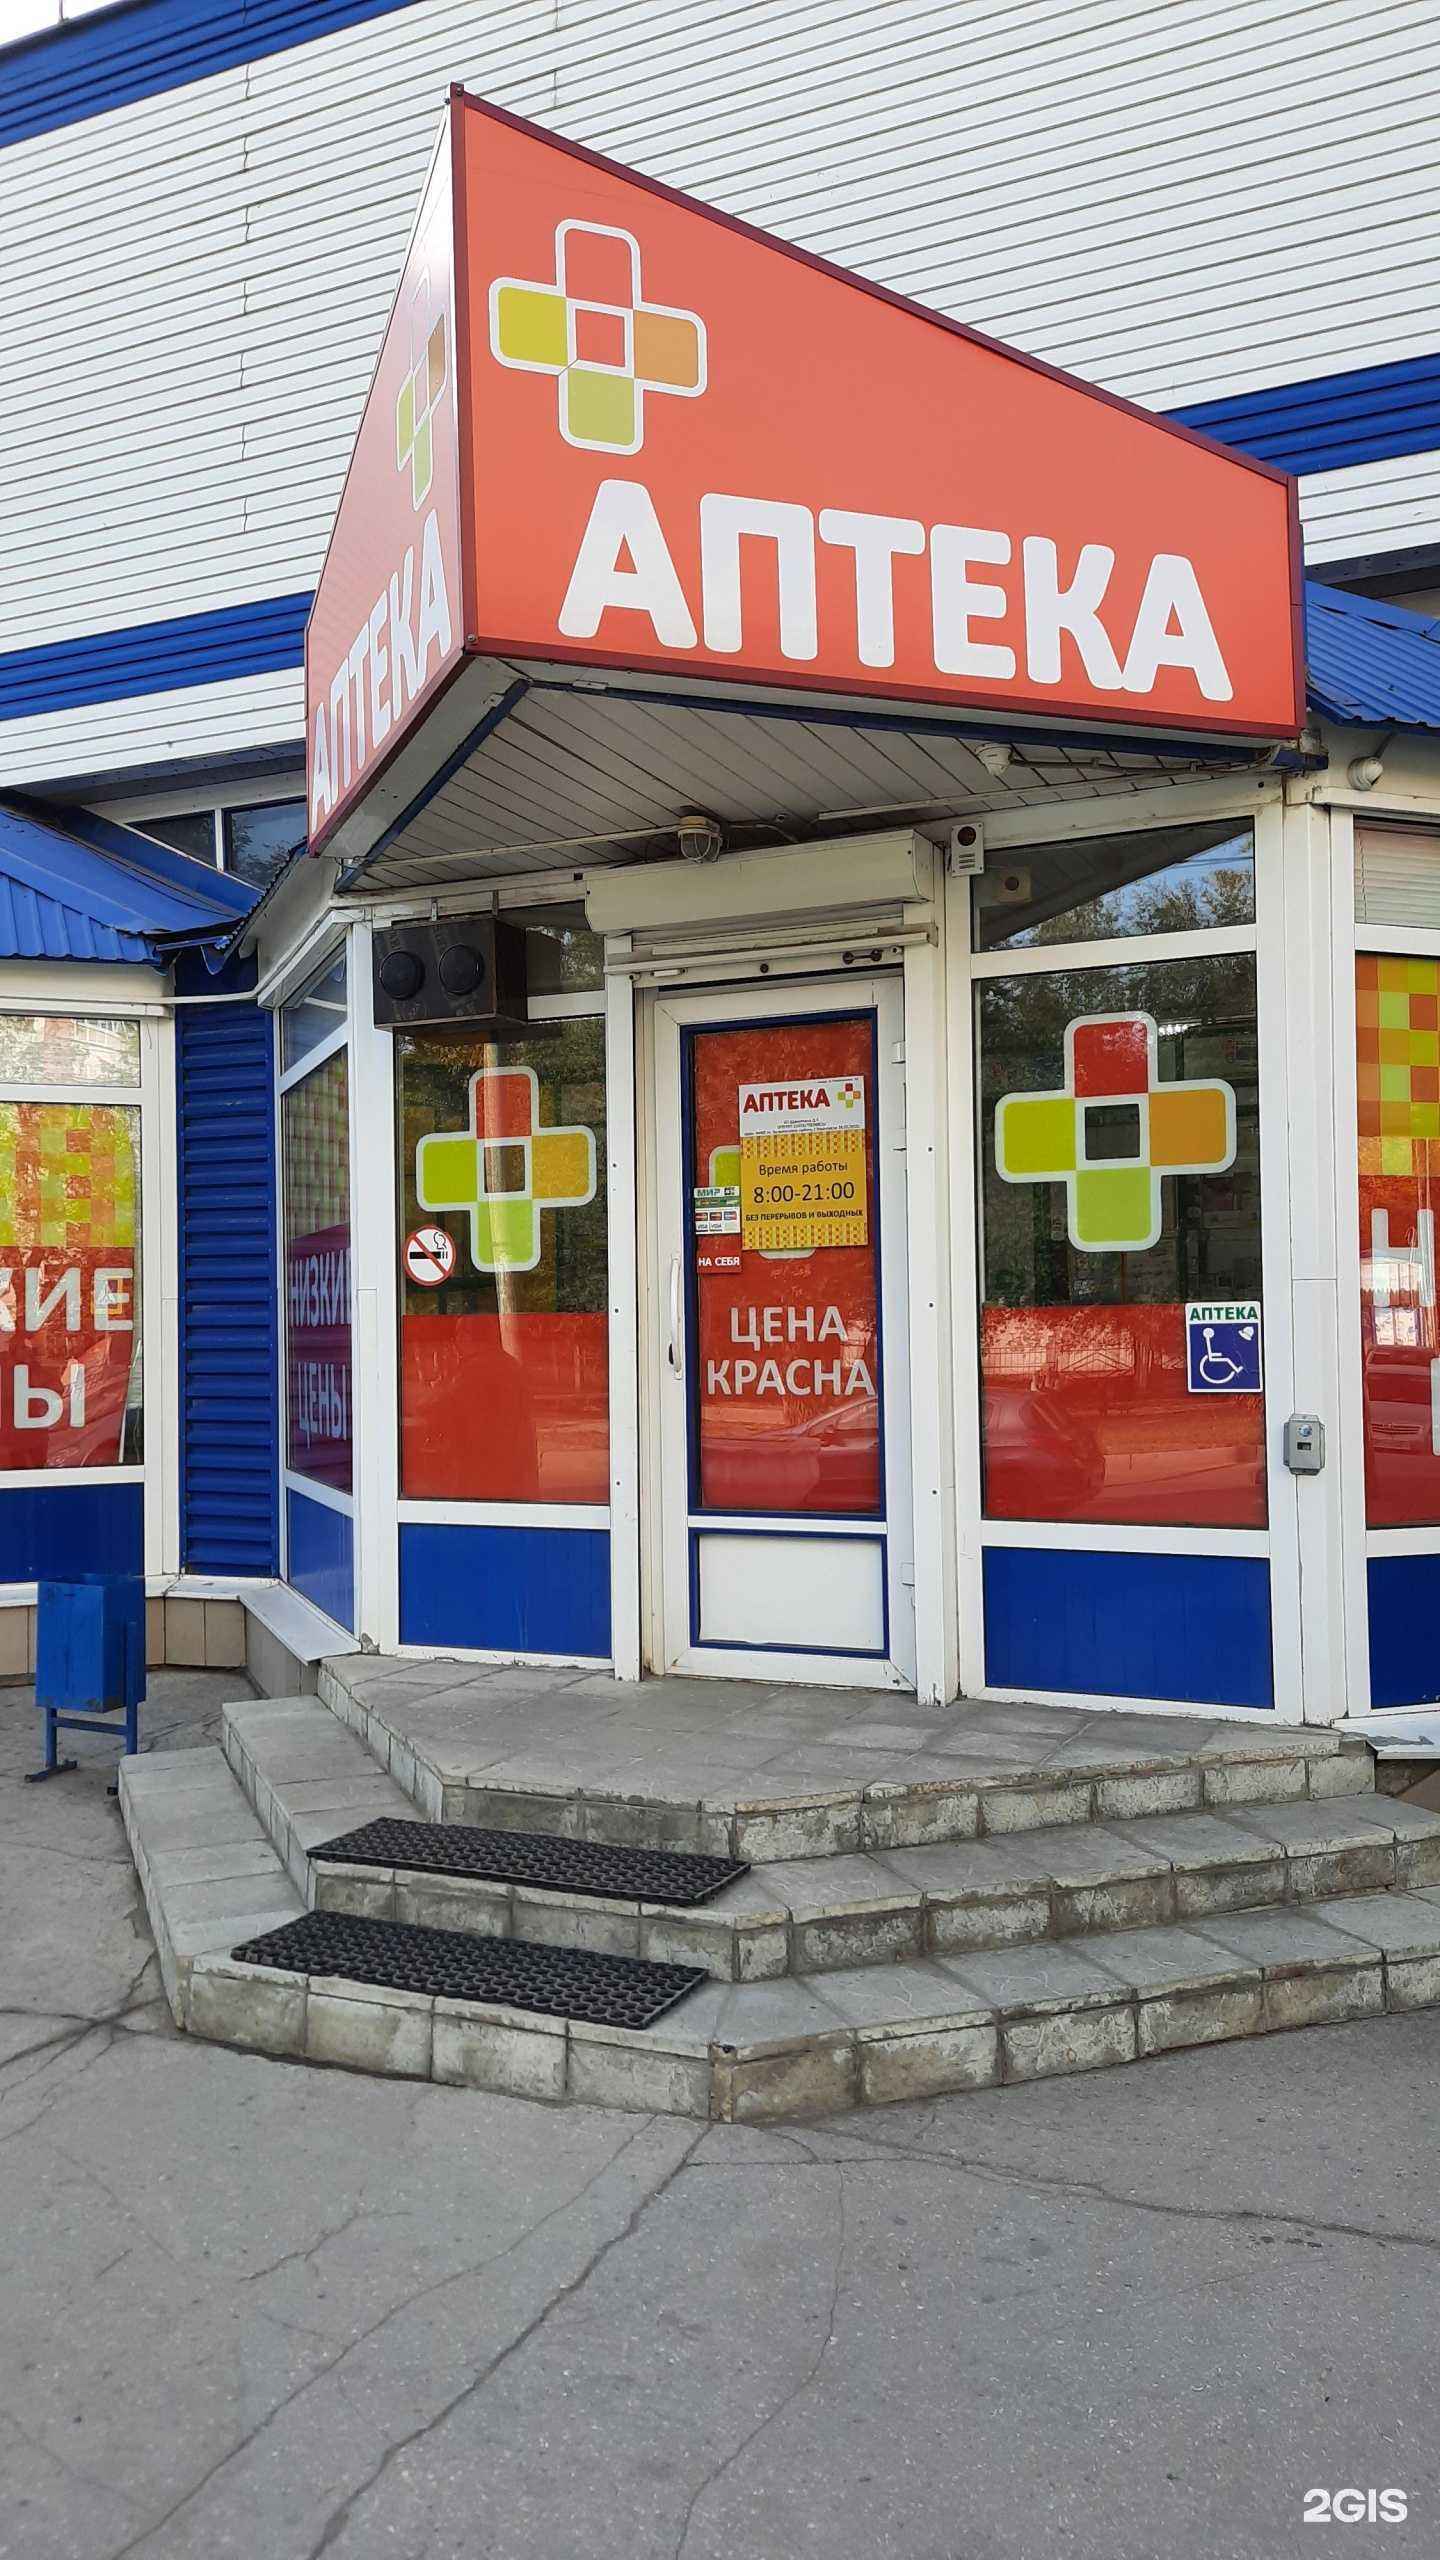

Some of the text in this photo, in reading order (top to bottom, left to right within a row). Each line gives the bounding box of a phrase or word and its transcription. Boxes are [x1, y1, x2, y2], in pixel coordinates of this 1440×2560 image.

[558, 478, 1233, 702] АПТЕКА
[312, 508, 451, 835] АПТЕКА
[743, 1088, 831, 1114] АПТЕКА
[758, 1160, 848, 1178] Время работы
[753, 1181, 855, 1204] 8:00-21:00
[760, 1211, 808, 1220] ПЕРЕРЫВОВ
[809, 1210, 815, 1218] И
[816, 1208, 864, 1218] ВЫХОДНЫХ
[698, 1256, 740, 1267] НА СЕБЯ
[1189, 1305, 1259, 1321] АПТЕКА
[730, 1305, 849, 1351] ЦЕНА
[707, 1359, 876, 1397] КРАСНА
[299, 1362, 347, 1448] ЦЕНЫ
